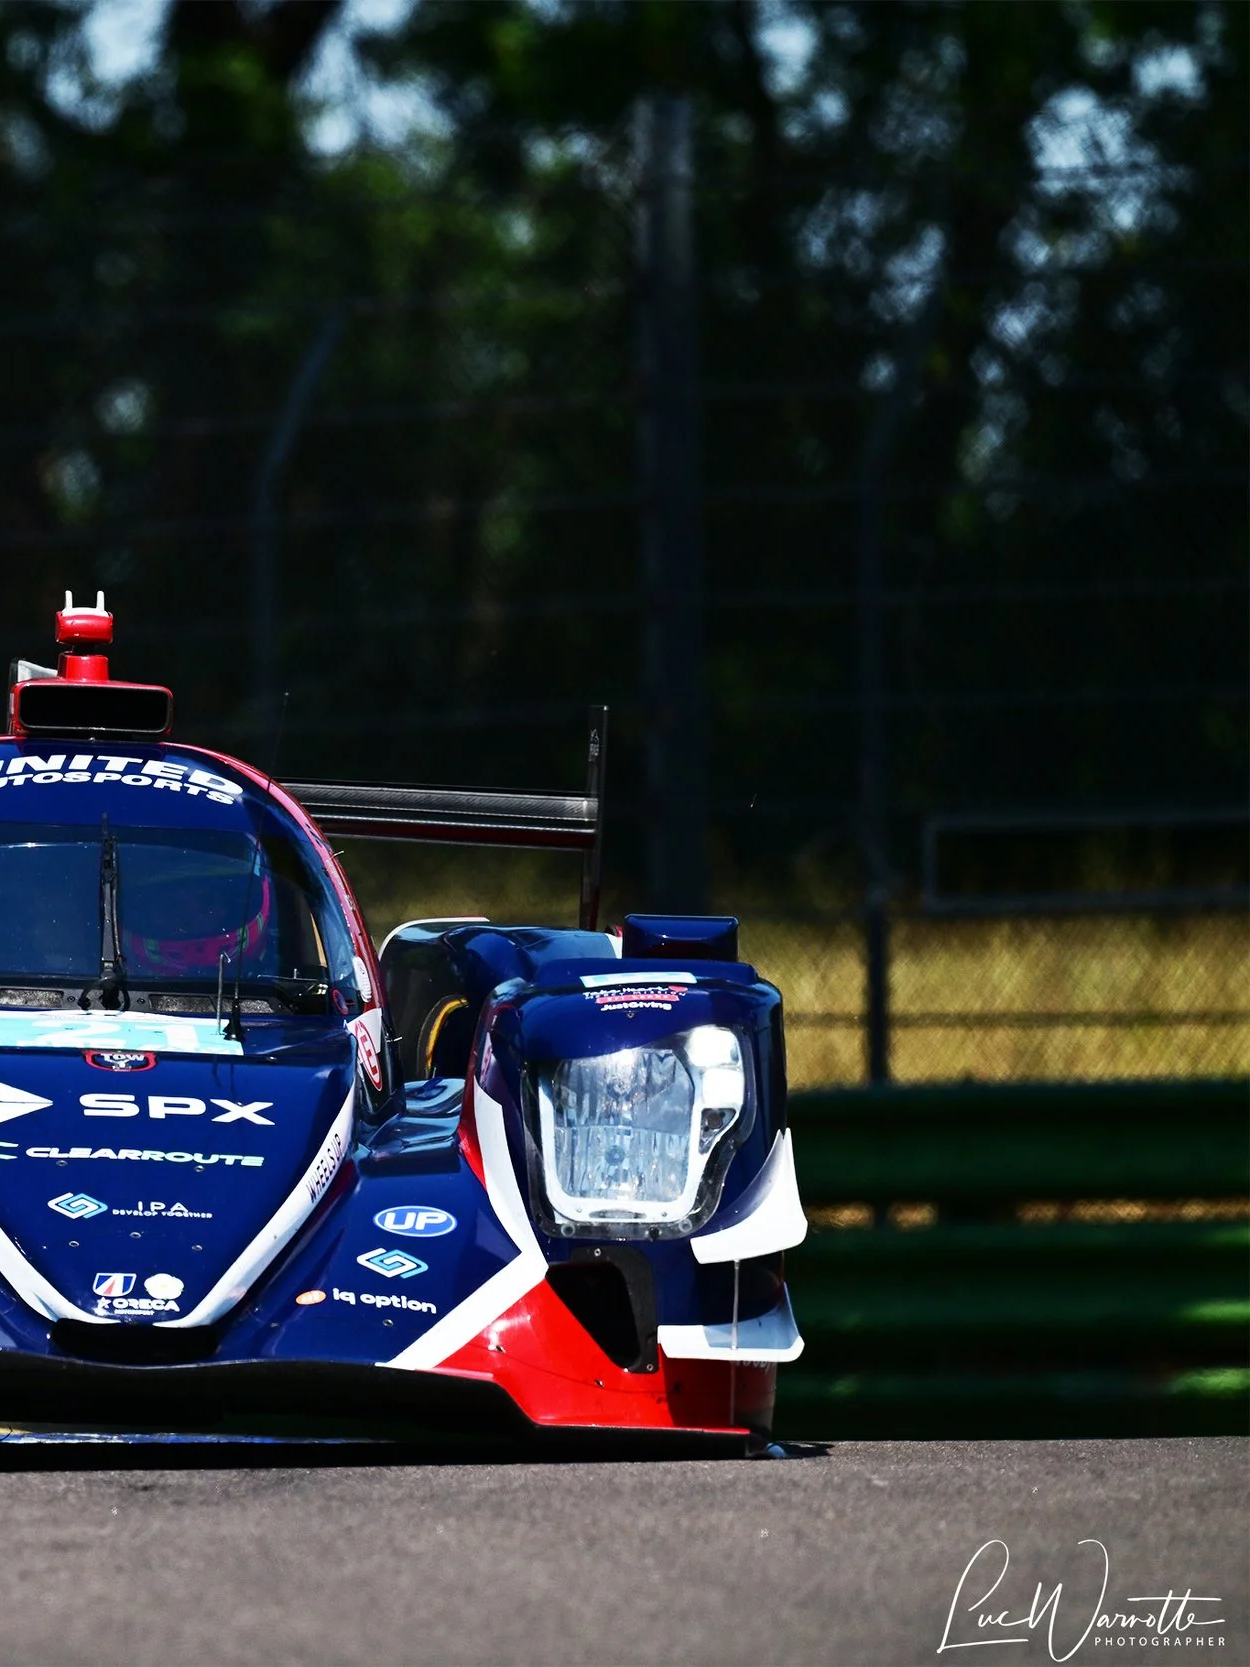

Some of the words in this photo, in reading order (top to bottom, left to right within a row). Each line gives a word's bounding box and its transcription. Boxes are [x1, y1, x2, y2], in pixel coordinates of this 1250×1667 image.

[600, 1002, 672, 1011] JustGiving
[17, 1018, 201, 1050] 21
[101, 1053, 145, 1062] TOW
[79, 1093, 275, 1125] SPX
[26, 1147, 265, 1166] CLEARROUTE
[306, 1148, 335, 1203] WHEELS
[331, 1133, 342, 1161] UP
[384, 1212, 447, 1230] UP
[112, 1298, 180, 1312] ORECA
[332, 1287, 356, 1305] iq
[360, 1293, 437, 1314] option
